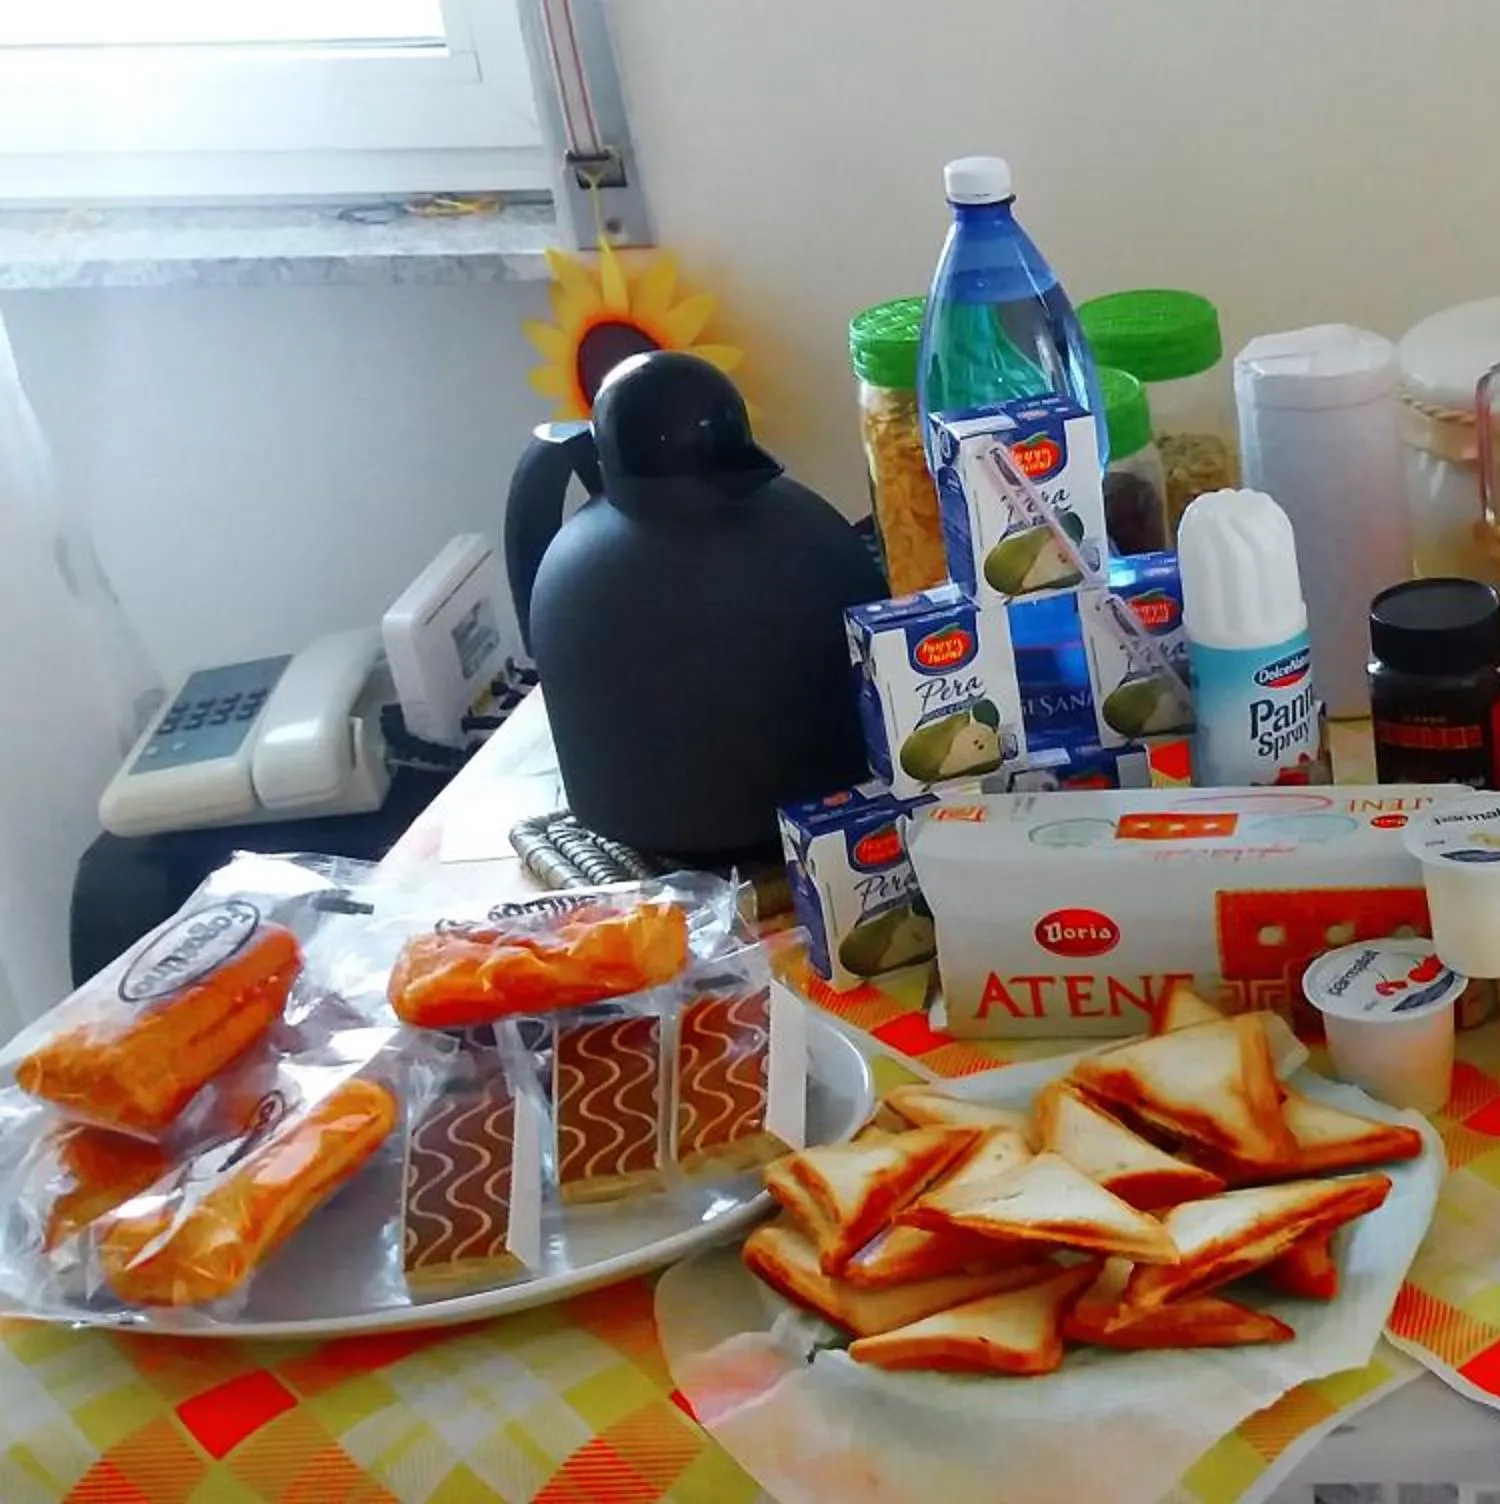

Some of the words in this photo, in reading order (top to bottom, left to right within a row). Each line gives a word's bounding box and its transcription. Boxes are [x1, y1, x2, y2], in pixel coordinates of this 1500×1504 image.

[914, 675, 985, 711] Pera
[1250, 683, 1316, 739] Pann
[1258, 720, 1312, 761] Spray
[1043, 922, 1113, 943] Doria
[971, 969, 1195, 1020] ATEN
